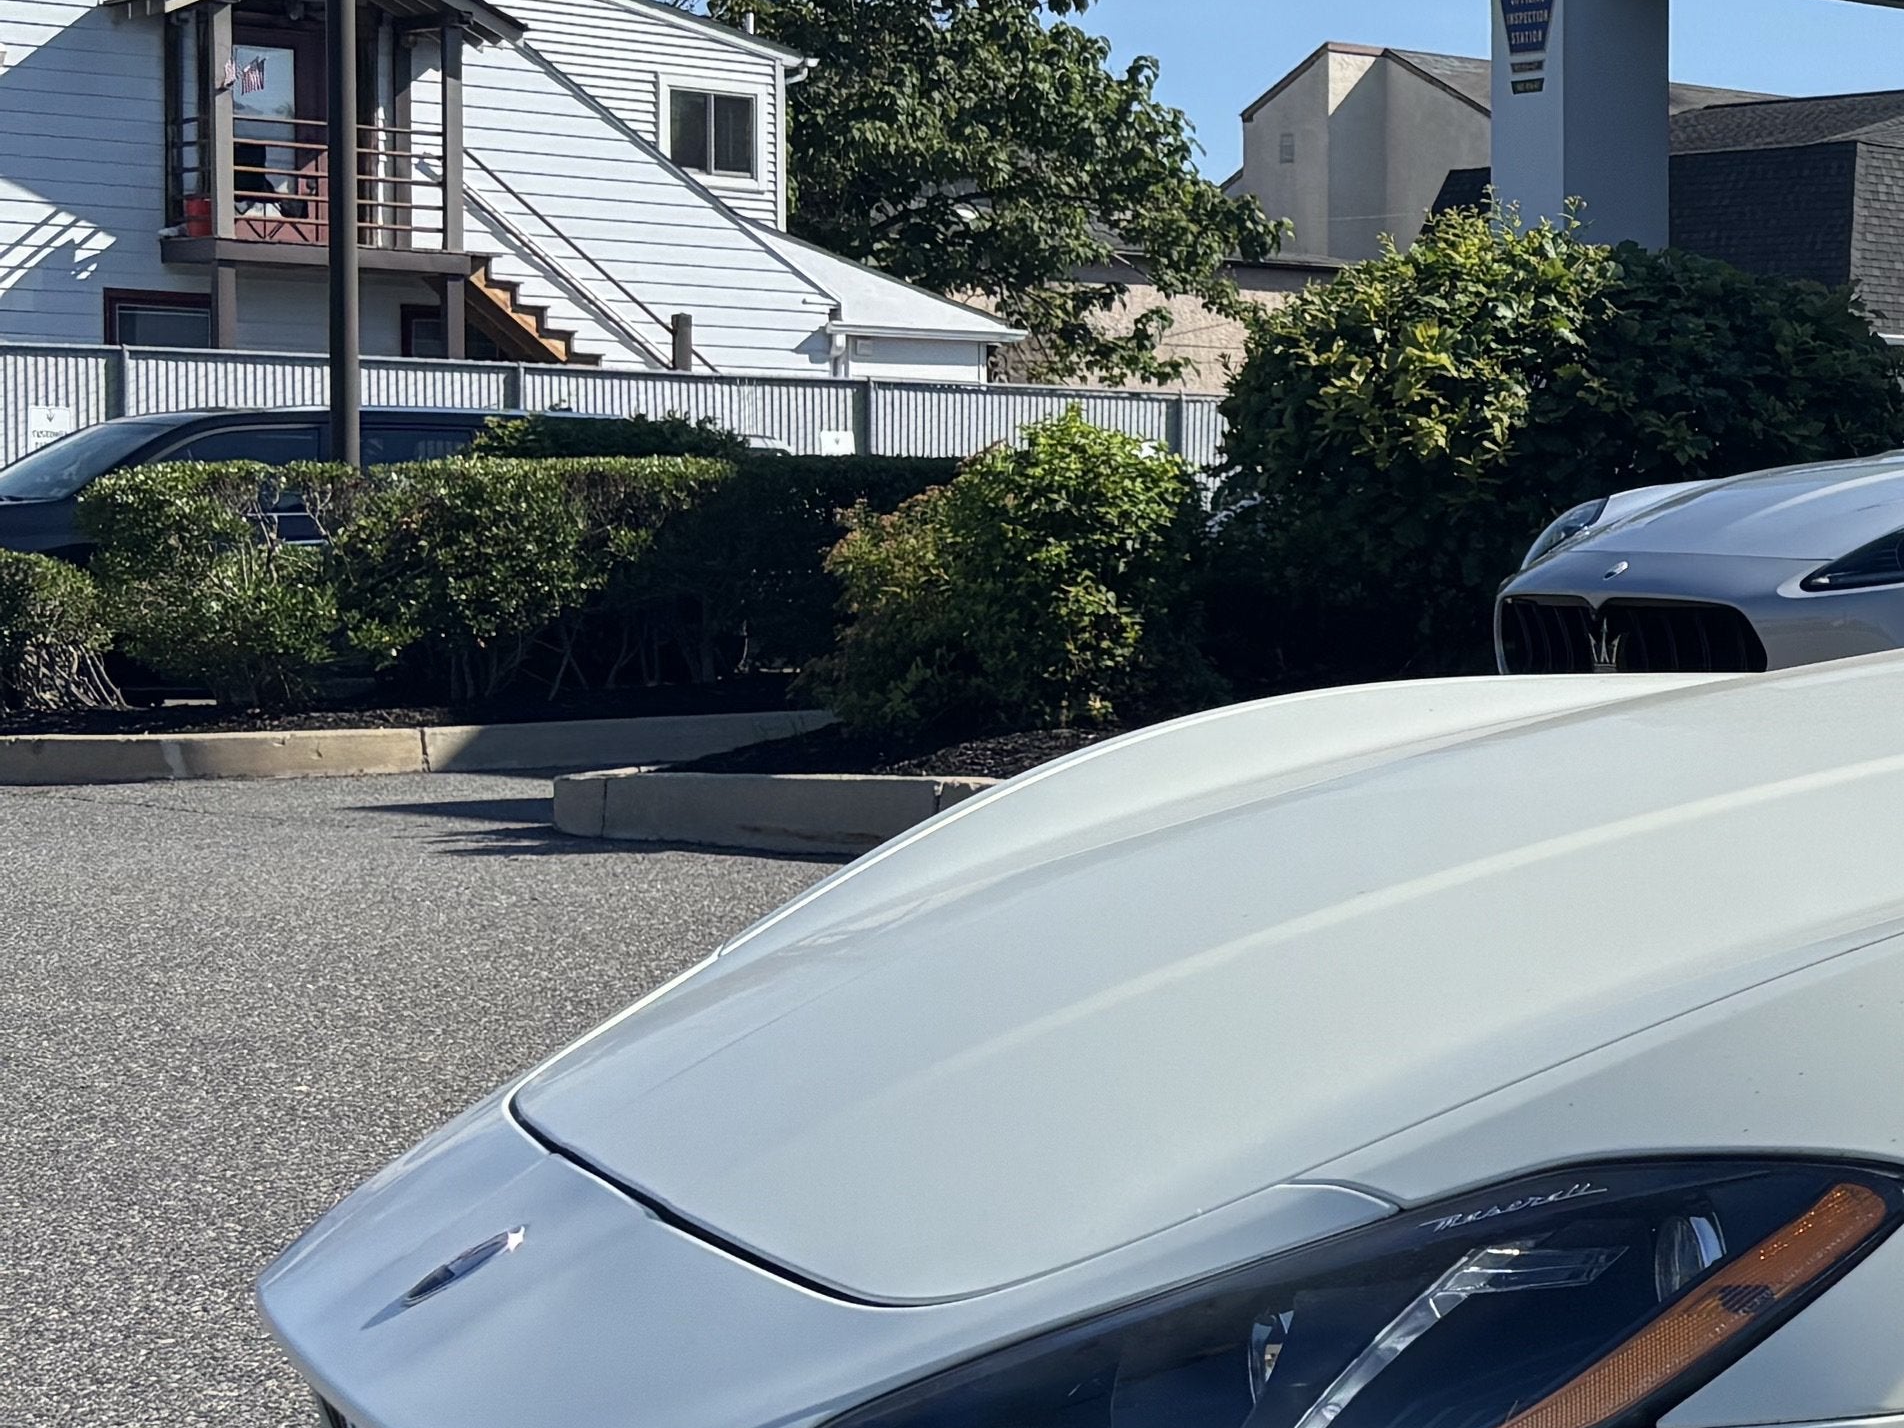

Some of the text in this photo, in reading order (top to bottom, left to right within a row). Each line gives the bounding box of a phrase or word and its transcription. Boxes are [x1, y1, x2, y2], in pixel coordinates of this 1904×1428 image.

[1506, 9, 1549, 26] INSPECTION
[1511, 30, 1543, 45] STATION
[1417, 1182, 1608, 1234] Maserati
